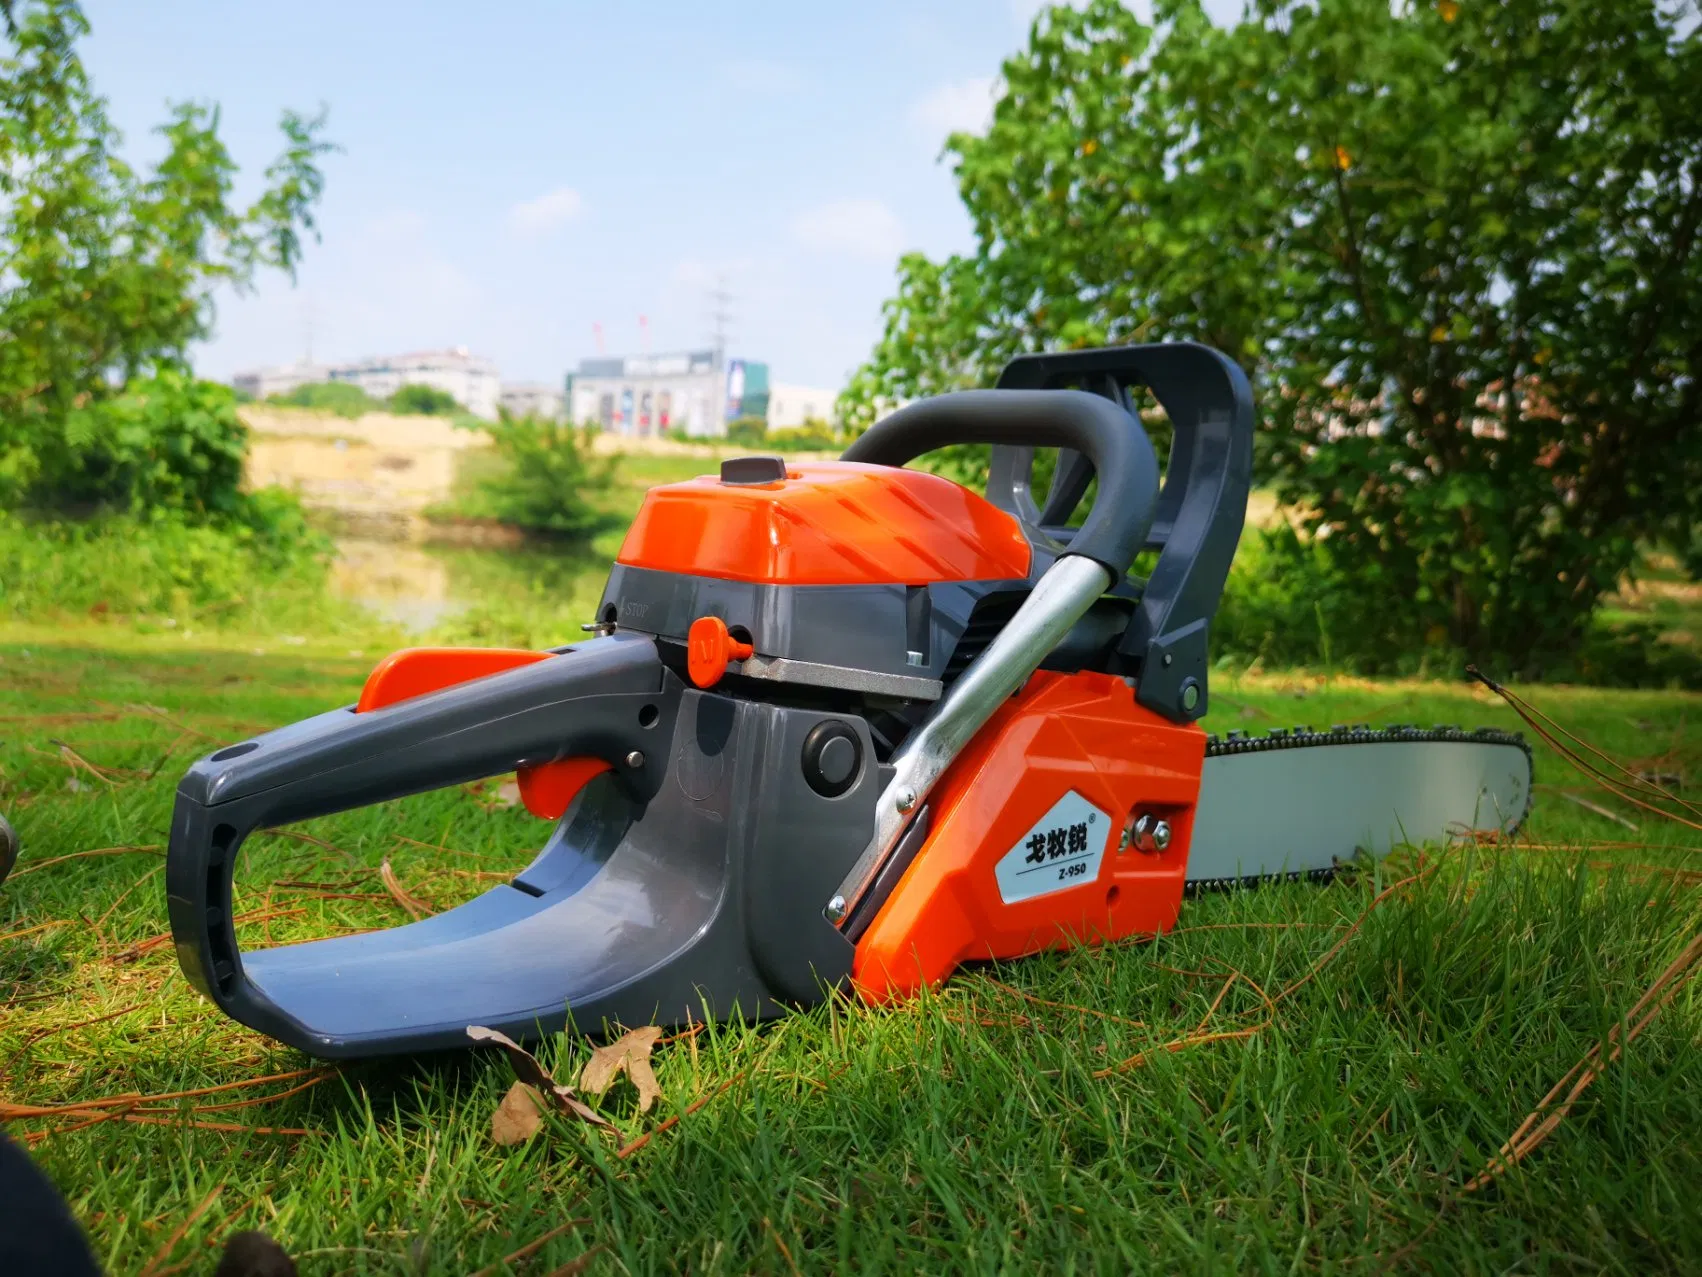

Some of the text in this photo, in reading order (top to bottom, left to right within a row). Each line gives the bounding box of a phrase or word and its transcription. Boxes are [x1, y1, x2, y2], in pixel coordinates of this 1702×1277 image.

[625, 602, 649, 618] STOP
[1025, 822, 1088, 864] 戈牧锐
[1058, 862, 1087, 880] Z-950
